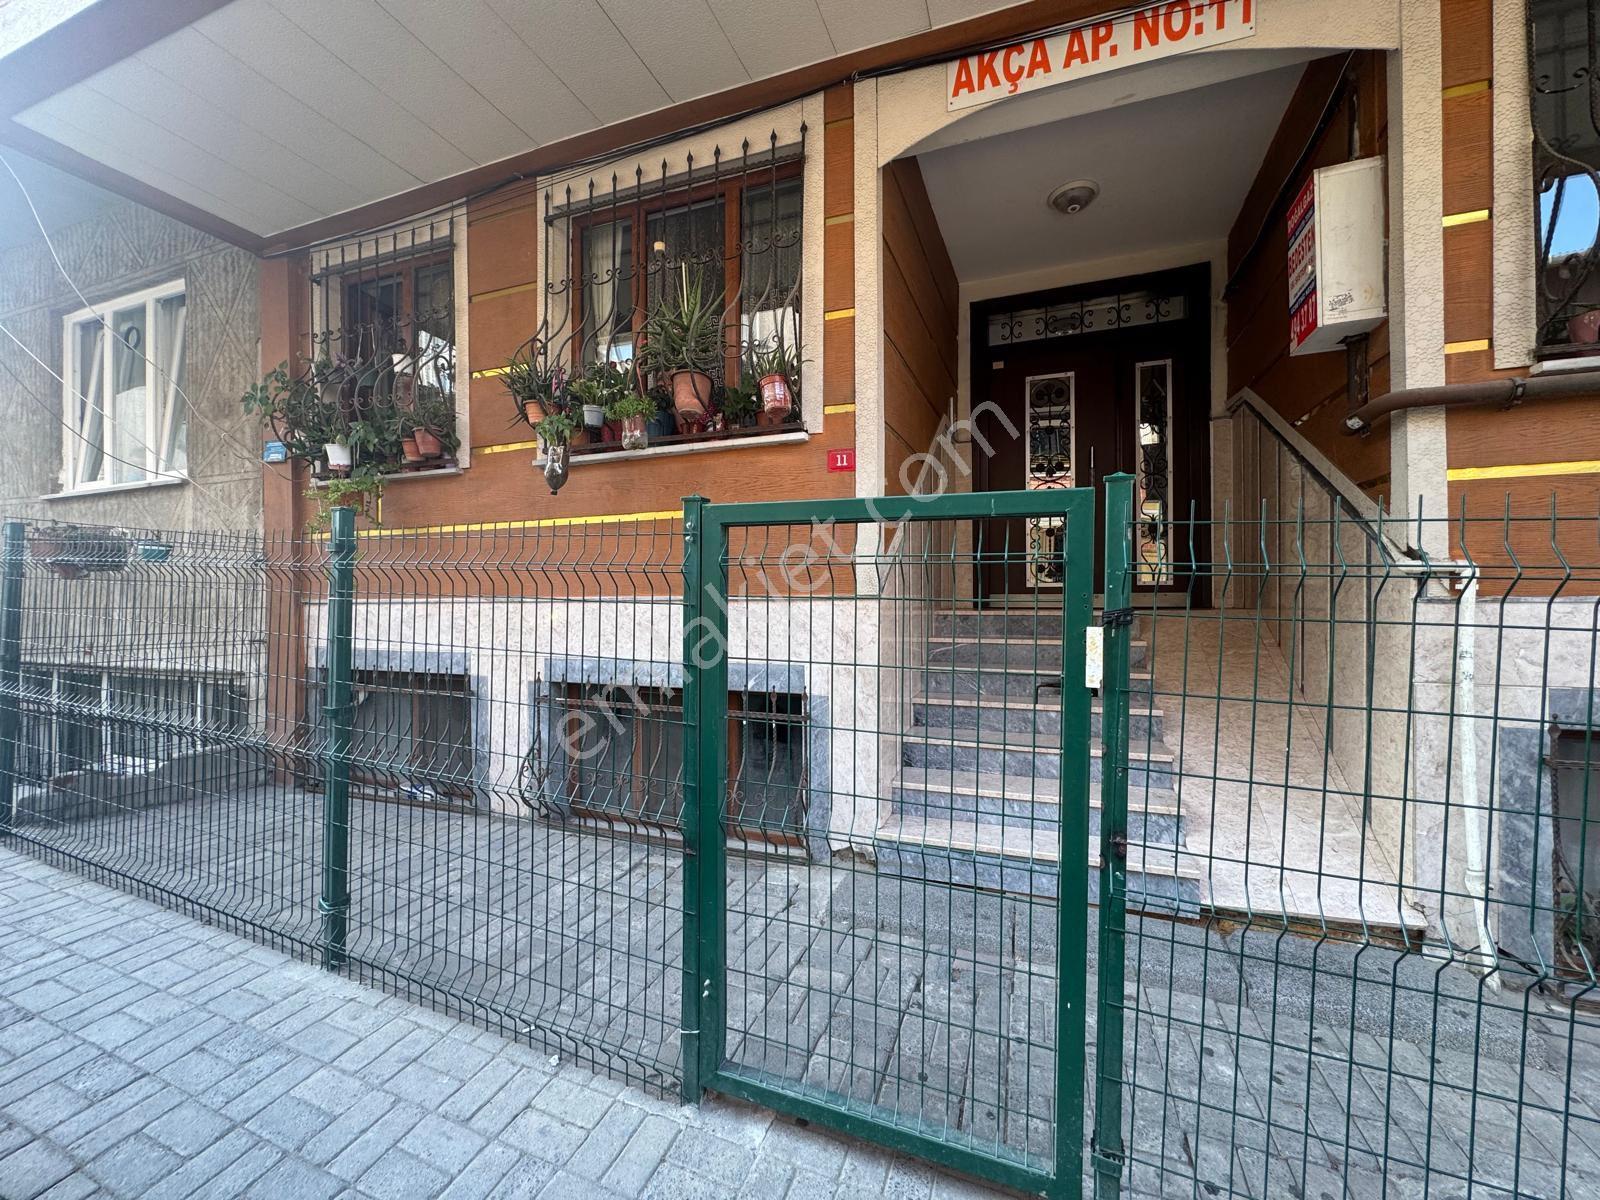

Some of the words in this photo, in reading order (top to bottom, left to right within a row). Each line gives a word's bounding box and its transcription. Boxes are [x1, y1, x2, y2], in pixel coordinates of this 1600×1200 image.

[951, 38, 1052, 98] AKÇA
[1062, 19, 1119, 70] AP.
[1133, 0, 1252, 51] NO:11
[836, 454, 848, 467] 11
